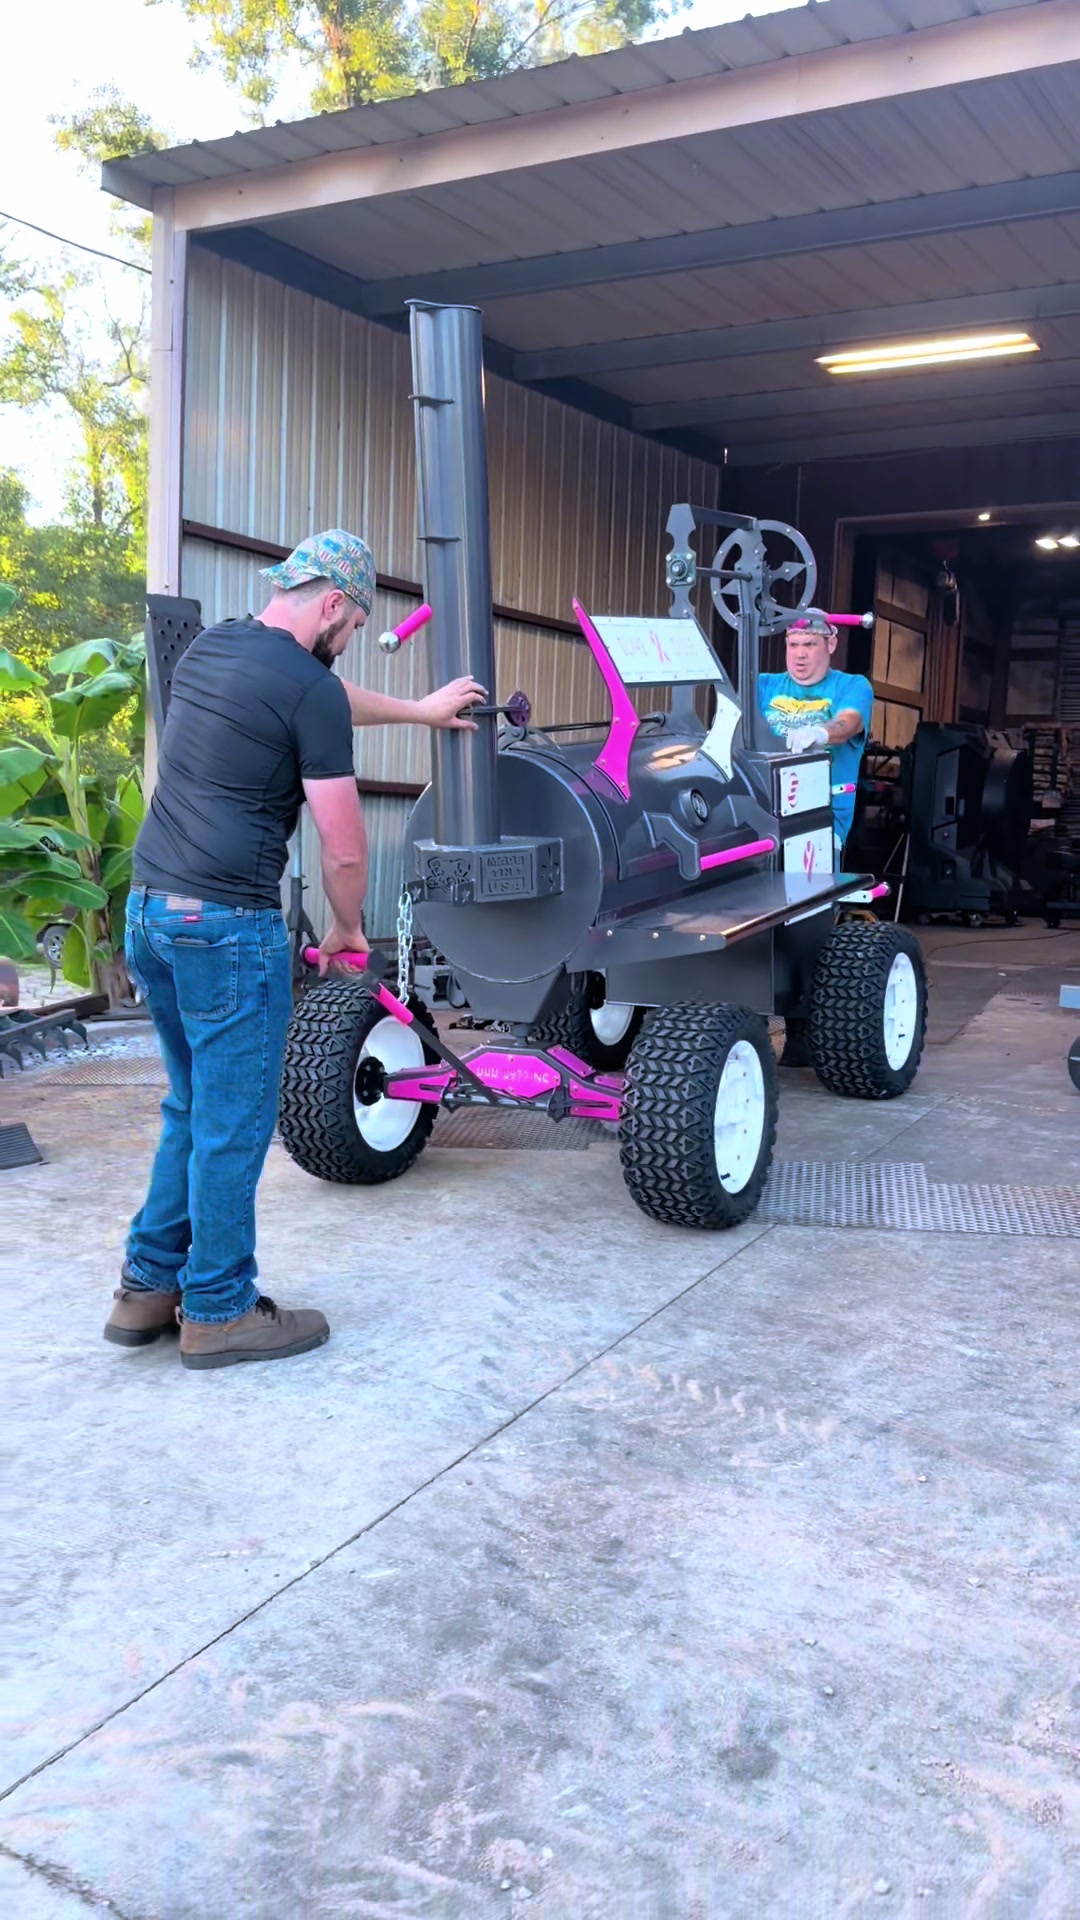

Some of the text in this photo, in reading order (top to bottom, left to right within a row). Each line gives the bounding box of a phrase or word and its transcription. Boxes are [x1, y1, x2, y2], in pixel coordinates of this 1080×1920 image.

[487, 855, 524, 867] MADE
[488, 880, 523, 893] USA
[533, 1072, 549, 1084] NC
